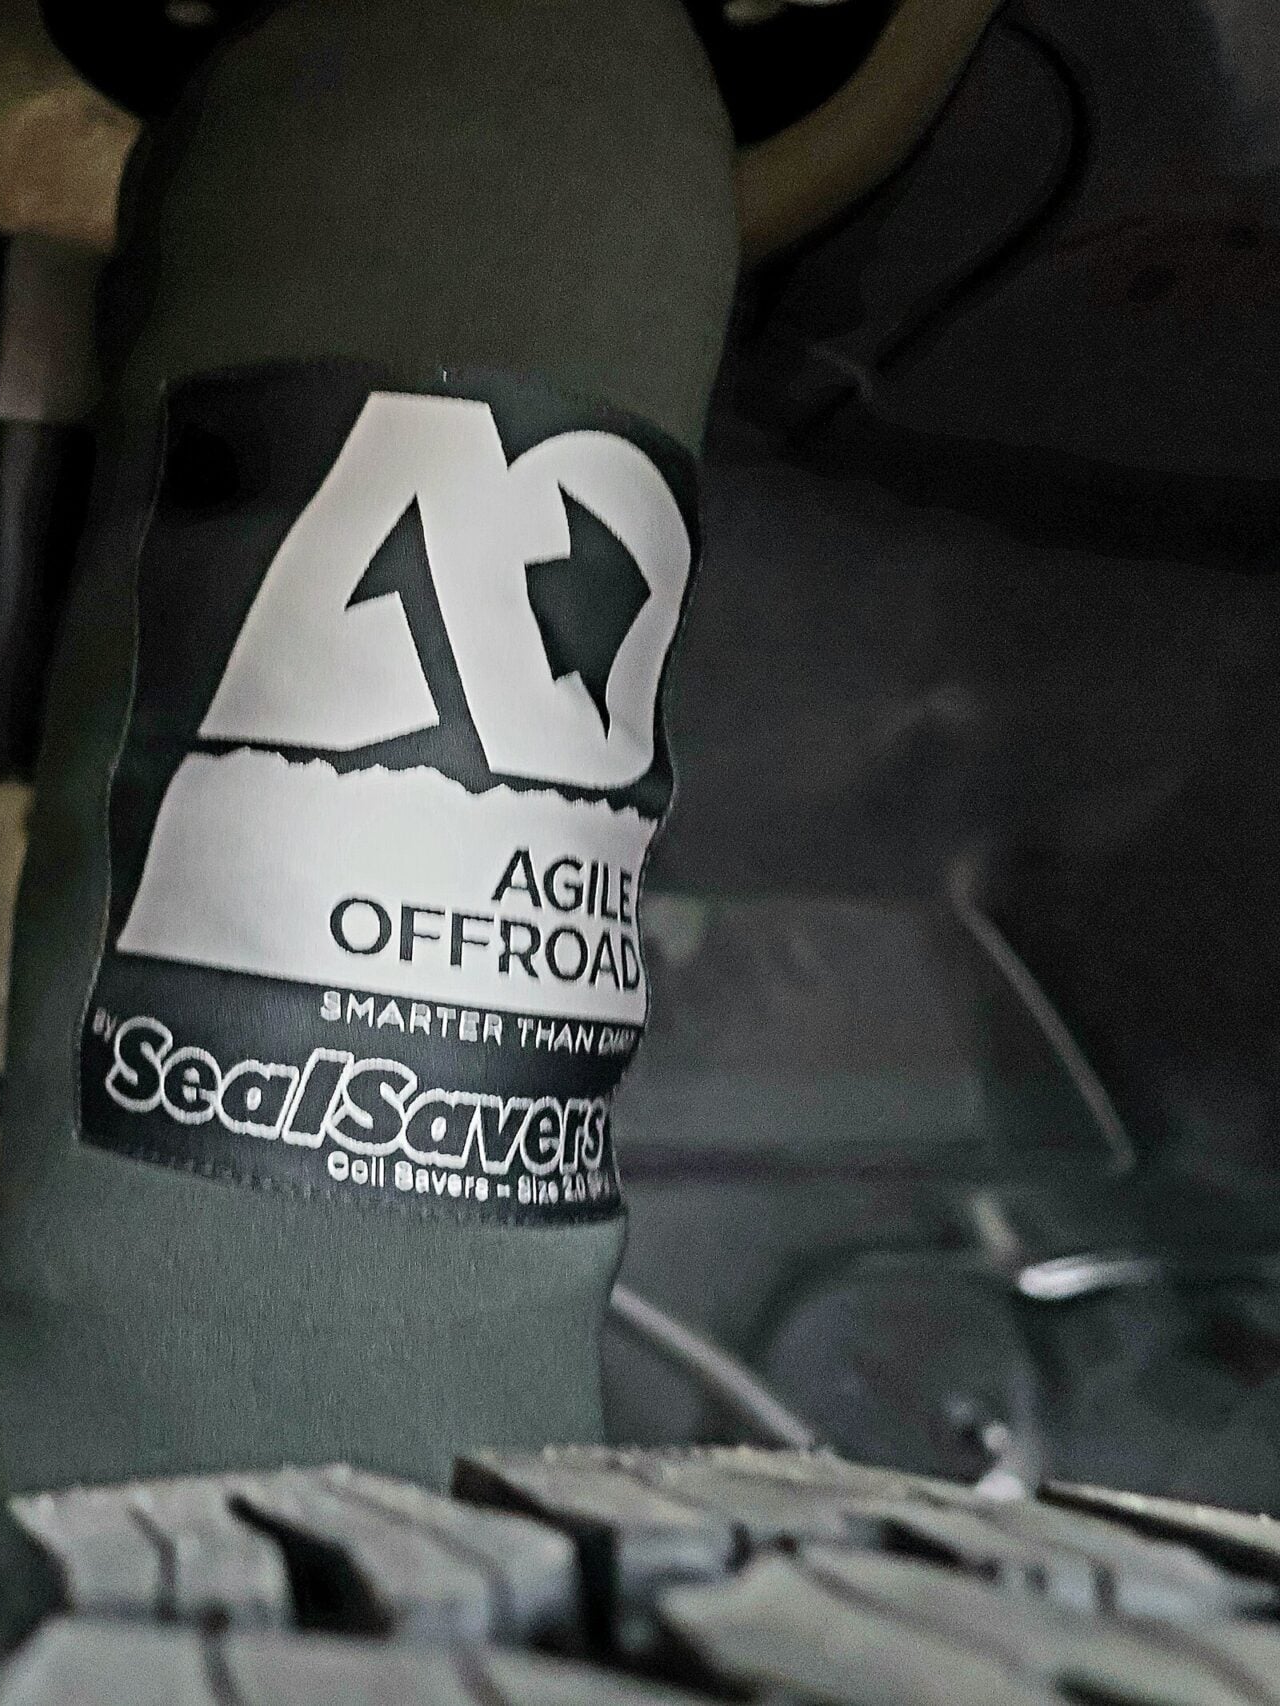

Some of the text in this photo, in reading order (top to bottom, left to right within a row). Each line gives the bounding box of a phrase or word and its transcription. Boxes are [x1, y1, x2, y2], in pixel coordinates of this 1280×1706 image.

[491, 846, 633, 925] AGILE
[329, 898, 641, 991] OFFROAD
[320, 990, 504, 1047] SMARTER
[517, 1016, 595, 1056] THAN
